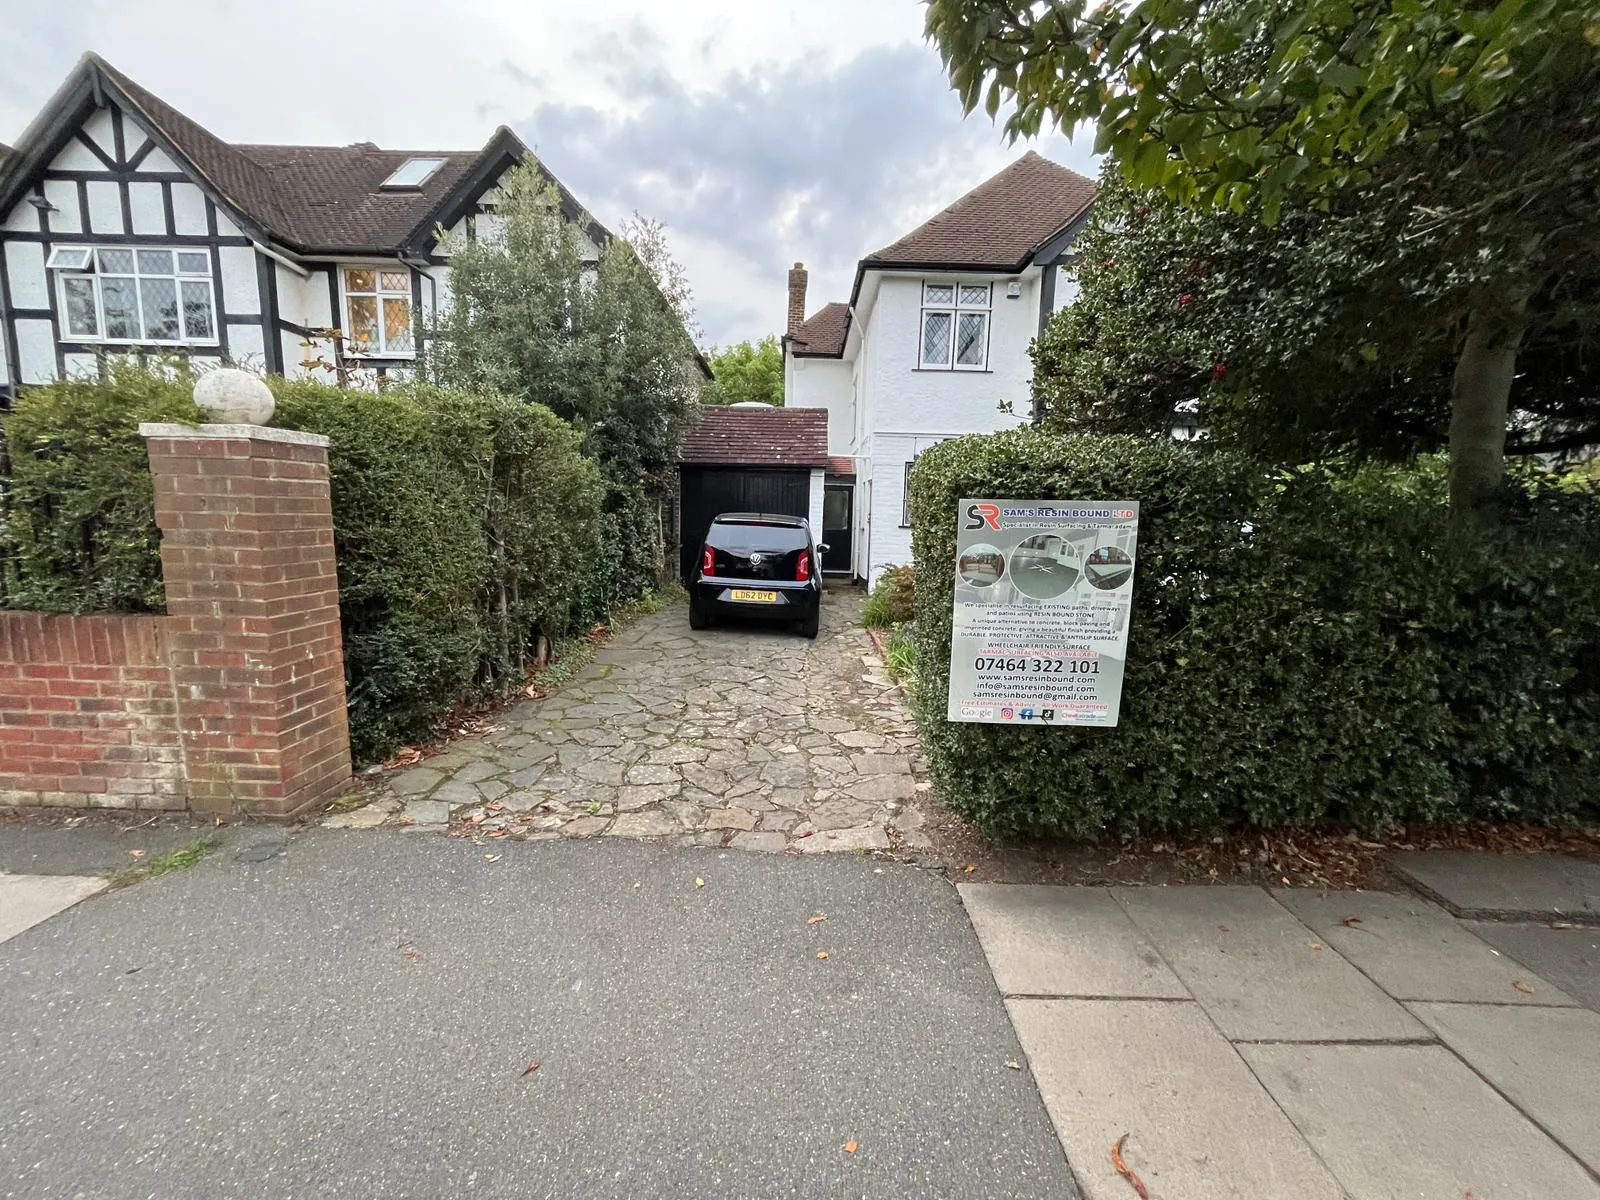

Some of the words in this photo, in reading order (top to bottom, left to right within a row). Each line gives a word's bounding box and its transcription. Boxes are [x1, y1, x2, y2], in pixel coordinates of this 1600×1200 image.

[964, 503, 1002, 531] SR
[1003, 508, 1035, 517] SAM'S
[1037, 508, 1068, 517] RESIN
[1072, 509, 1110, 518] BOUND
[1112, 509, 1133, 518] LTD
[735, 591, 756, 600] LD62
[975, 657, 1027, 672] 07464
[1032, 659, 1064, 673] 322
[1070, 660, 1100, 674] 101
[977, 675, 1096, 684] www.samsresinbound.com
[976, 683, 1095, 692] info@samsresinbound.com
[973, 691, 1098, 701] samsresinbound@gmail.com
